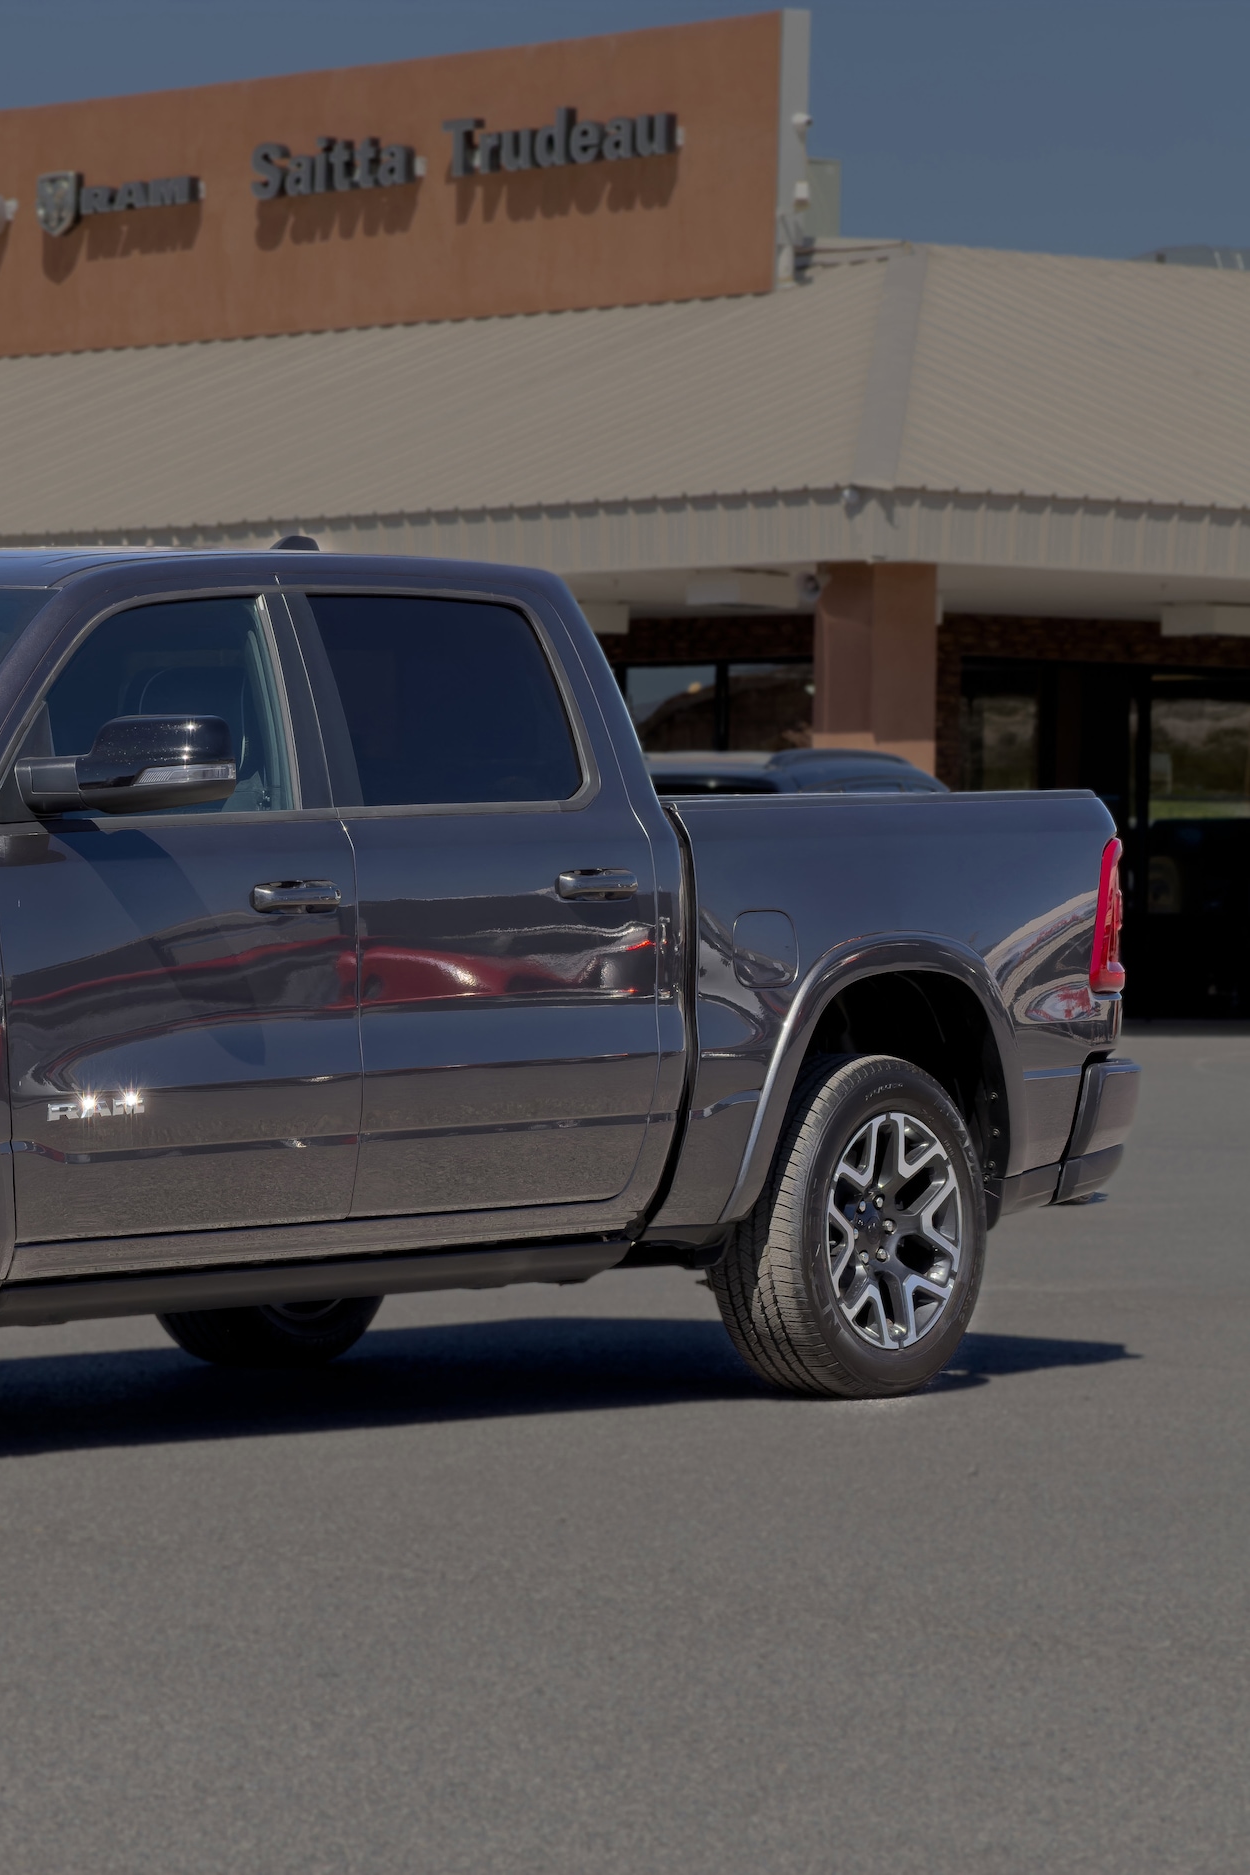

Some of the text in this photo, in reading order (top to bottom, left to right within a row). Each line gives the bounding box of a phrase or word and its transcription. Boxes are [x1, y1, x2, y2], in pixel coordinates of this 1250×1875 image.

[250, 106, 674, 200] Saitta Trudeau
[81, 175, 193, 215] RAM
[47, 1097, 145, 1121] RAM
